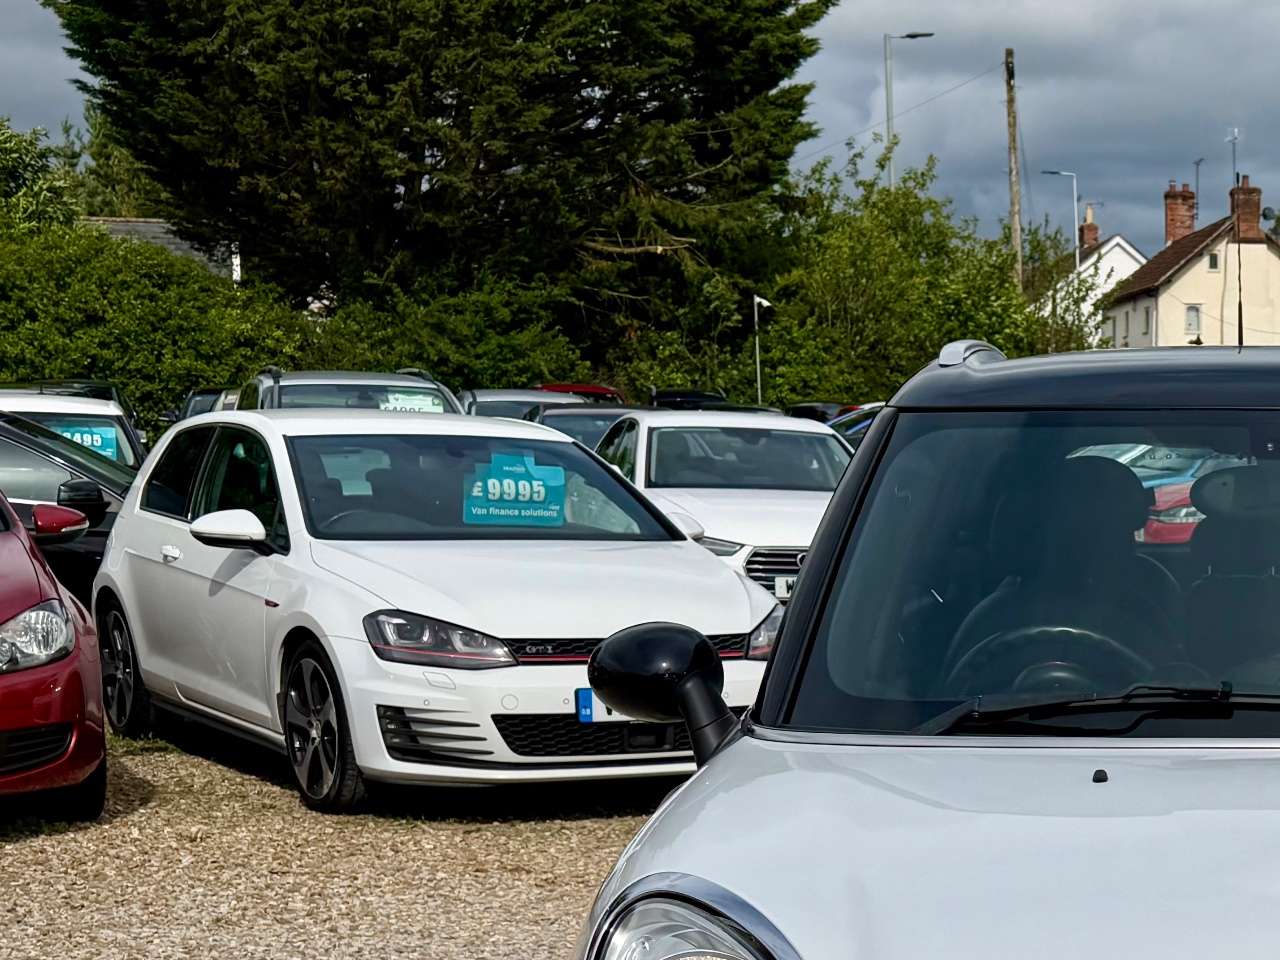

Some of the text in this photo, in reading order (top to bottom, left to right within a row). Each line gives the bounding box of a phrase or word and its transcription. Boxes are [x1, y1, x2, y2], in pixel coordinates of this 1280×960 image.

[472, 506, 487, 515] Van
[489, 507, 518, 516] finance
[521, 508, 558, 517] solutions
[526, 645, 553, 654] GTI
